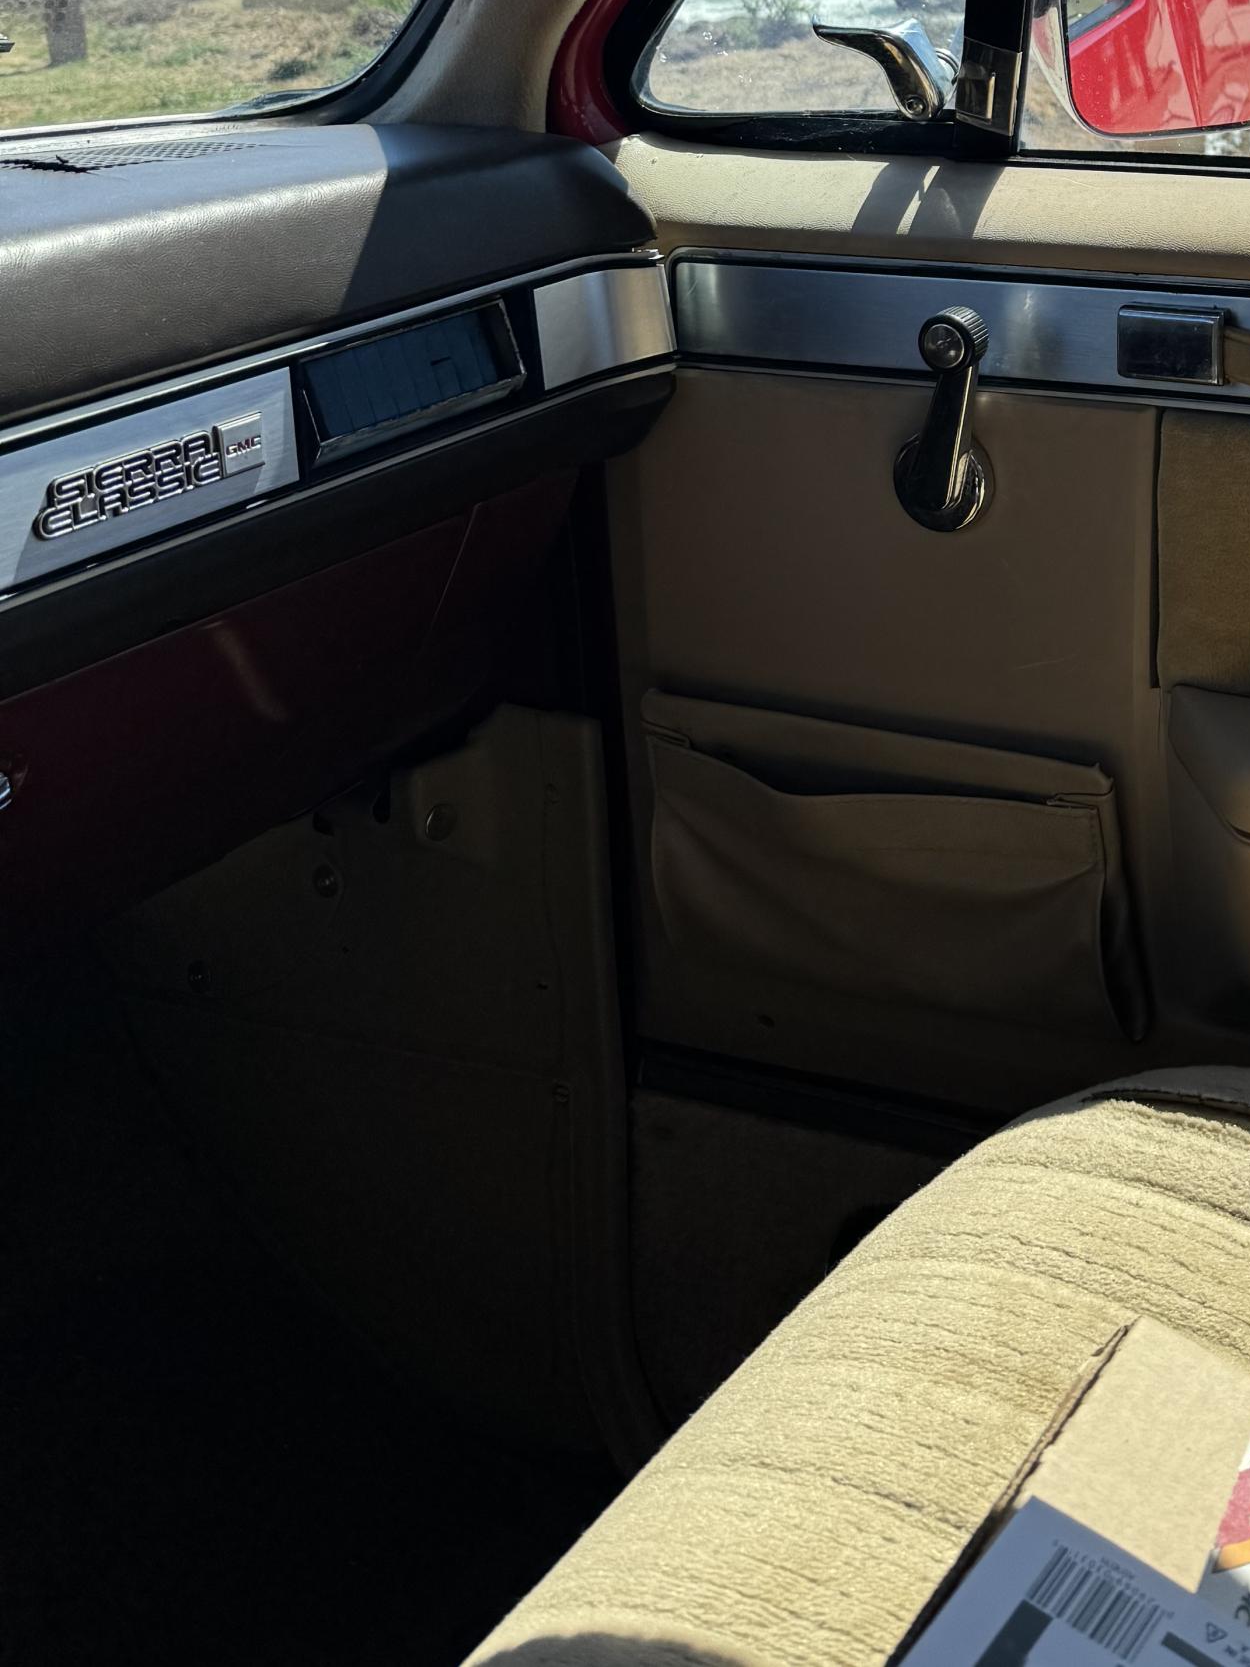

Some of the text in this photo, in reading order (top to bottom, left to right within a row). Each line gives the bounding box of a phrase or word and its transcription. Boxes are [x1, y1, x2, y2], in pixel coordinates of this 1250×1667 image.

[51, 430, 217, 506] SIERRA
[225, 435, 262, 458] GMC
[34, 453, 222, 539] CLASSIC
